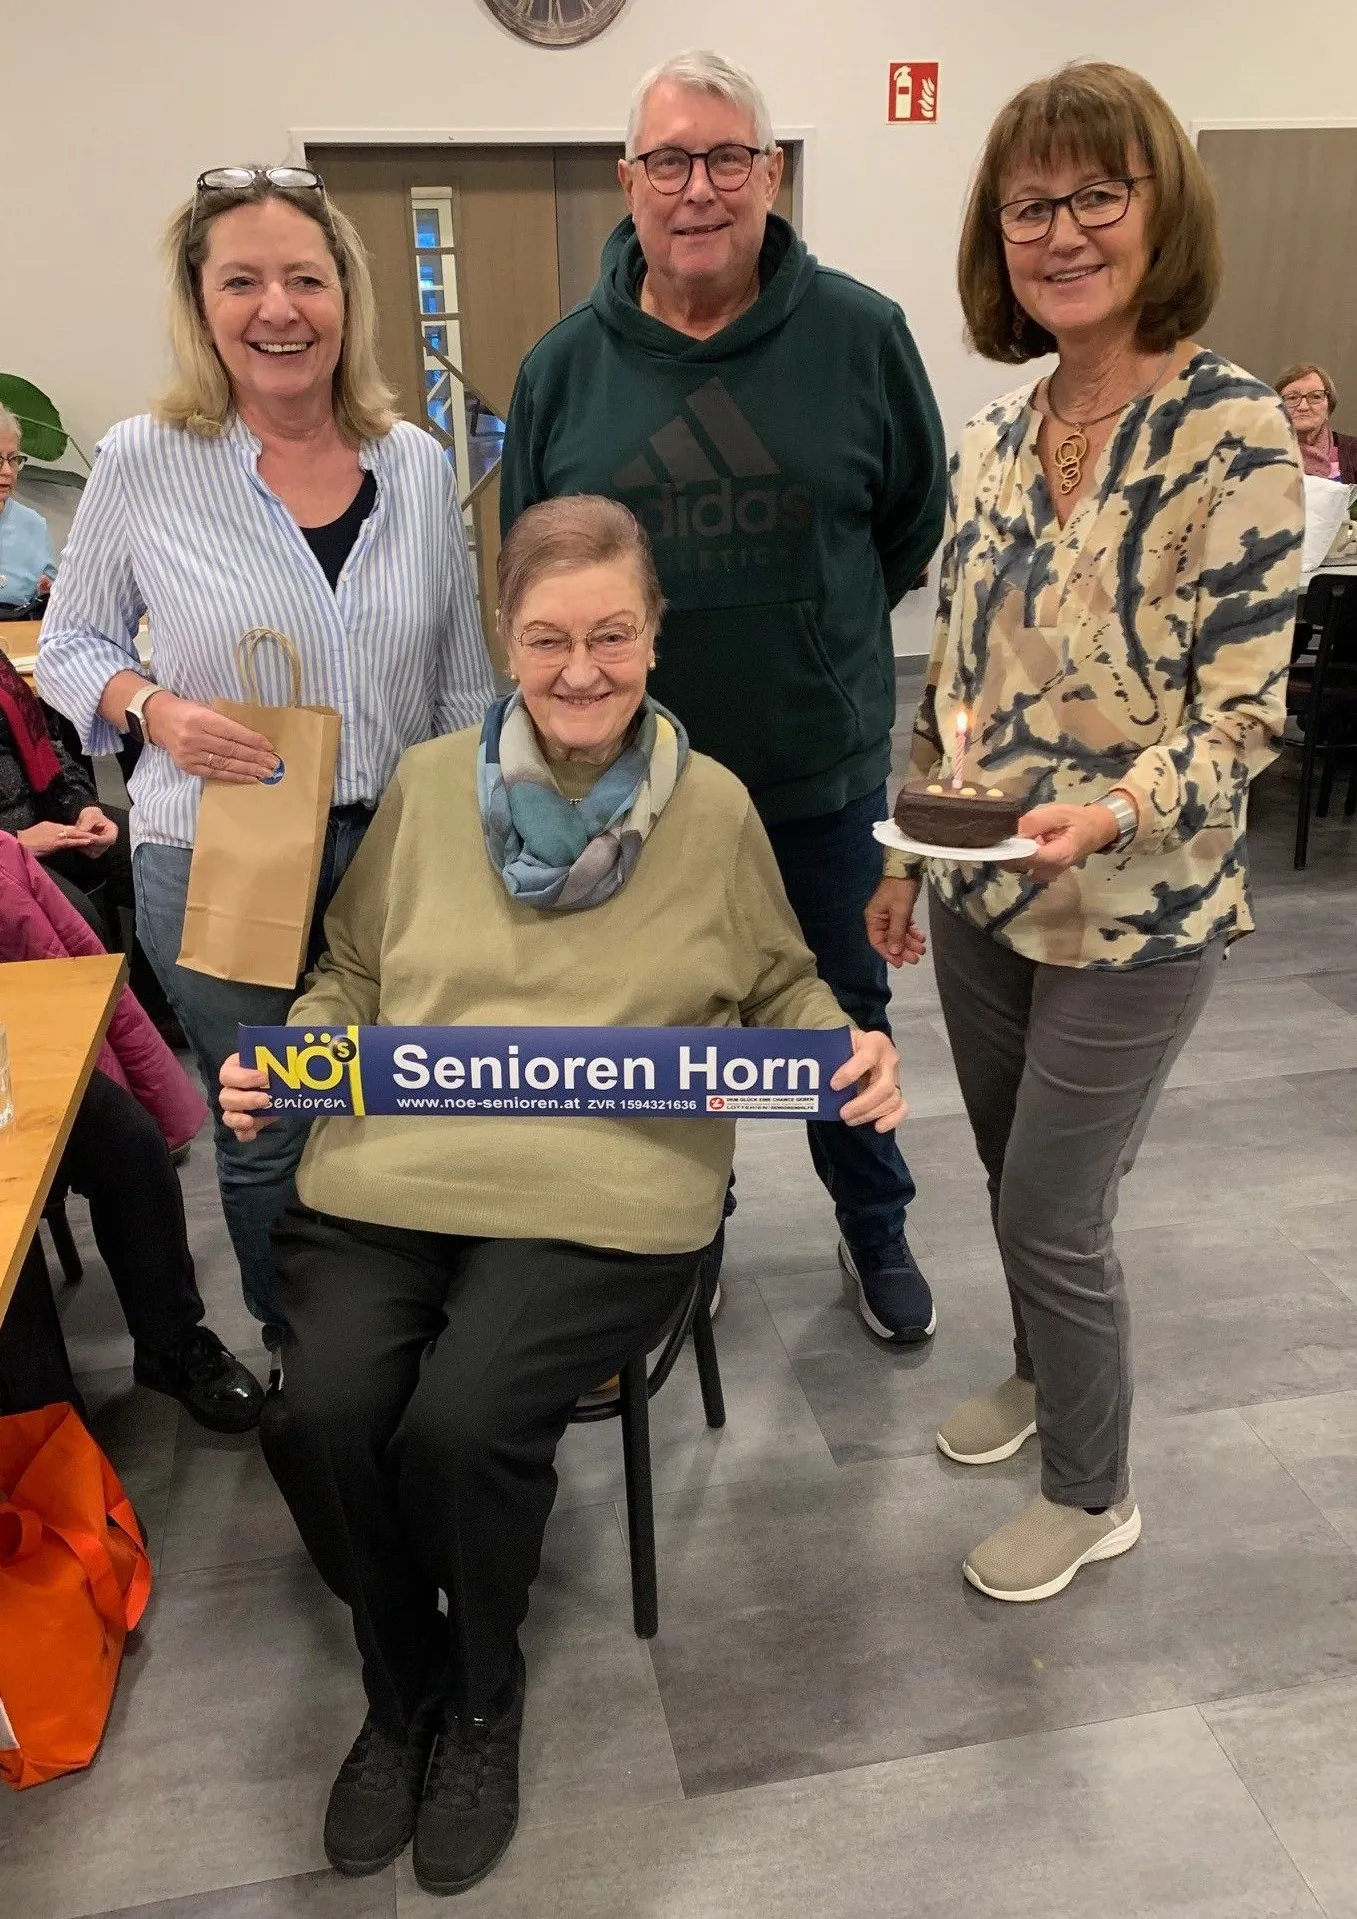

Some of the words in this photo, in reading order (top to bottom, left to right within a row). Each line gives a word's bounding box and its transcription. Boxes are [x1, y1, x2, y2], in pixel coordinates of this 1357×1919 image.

[392, 1043, 655, 1091] Senioren
[678, 1045, 821, 1091] Horn
[396, 1096, 581, 1110] www.noe-senioren.at
[587, 1099, 616, 1110] ZVR
[619, 1098, 698, 1111] 1594321636
